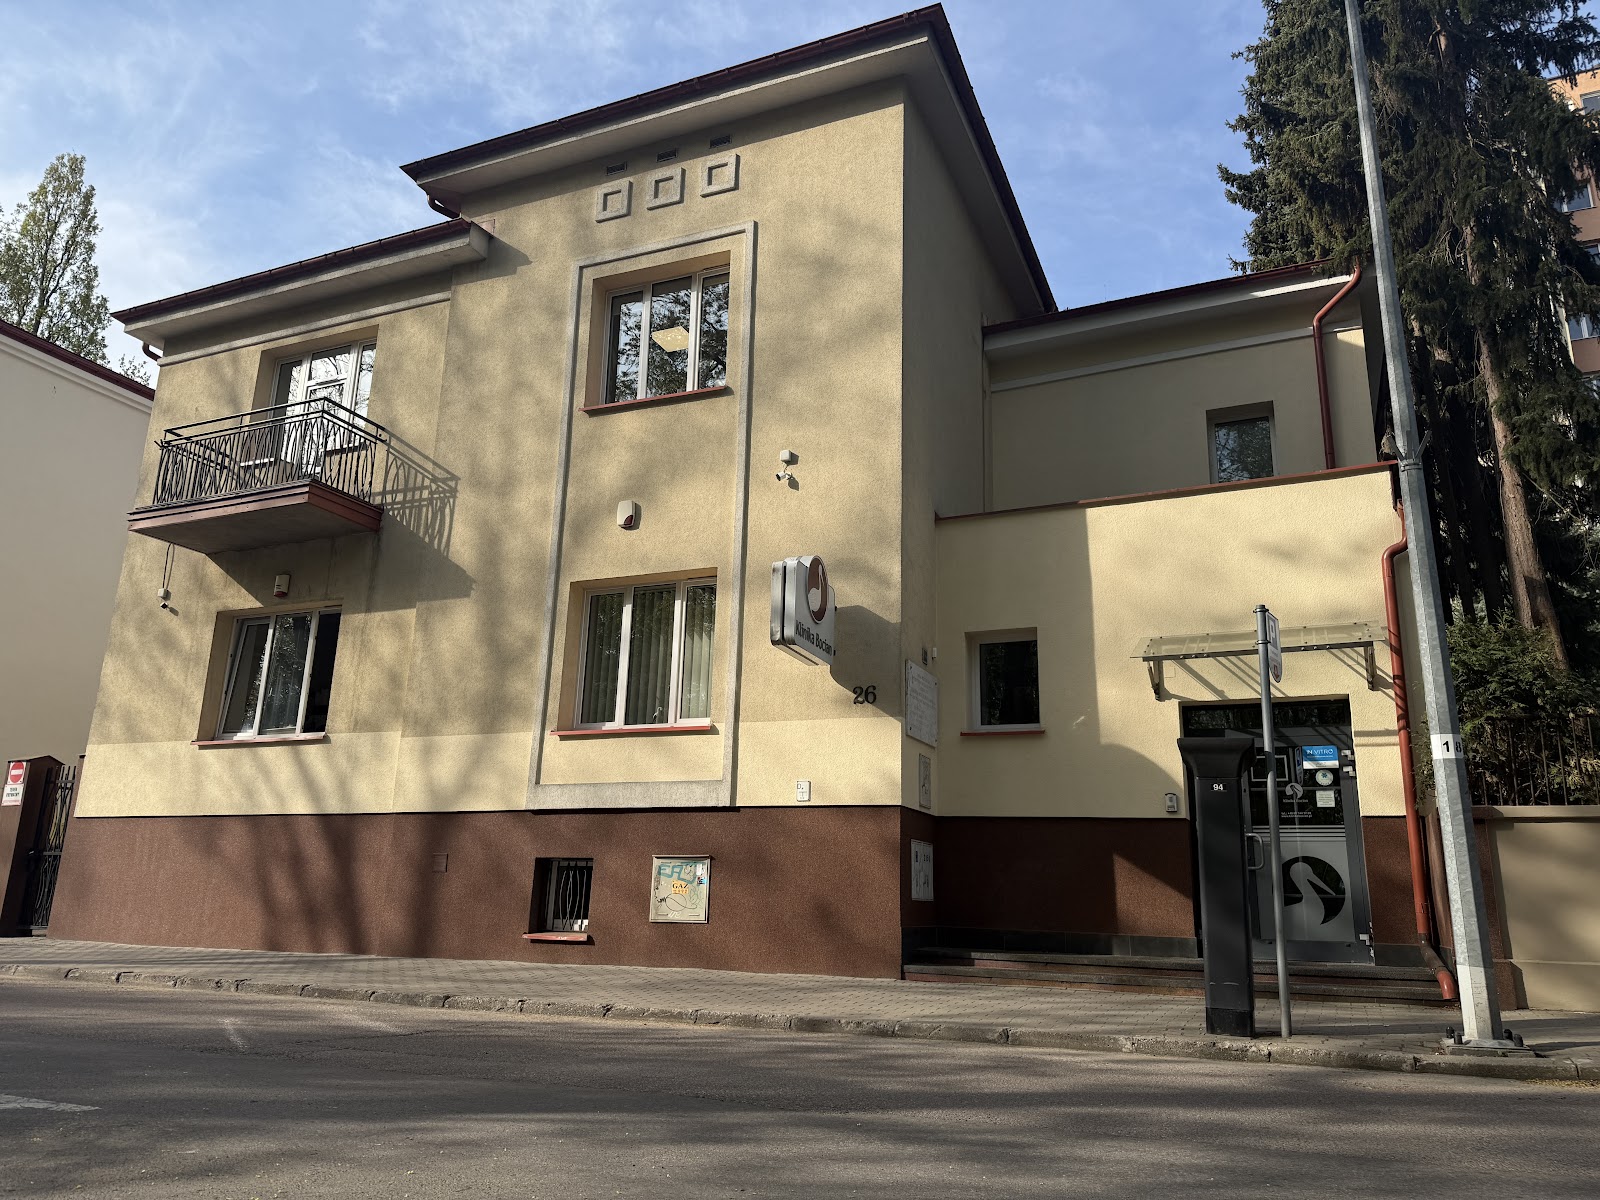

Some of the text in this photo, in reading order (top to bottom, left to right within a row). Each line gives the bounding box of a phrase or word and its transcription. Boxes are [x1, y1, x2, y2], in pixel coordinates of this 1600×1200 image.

[796, 620, 833, 656] Klinika Bocian
[852, 685, 877, 705] 26
[1213, 783, 1224, 791] 94
